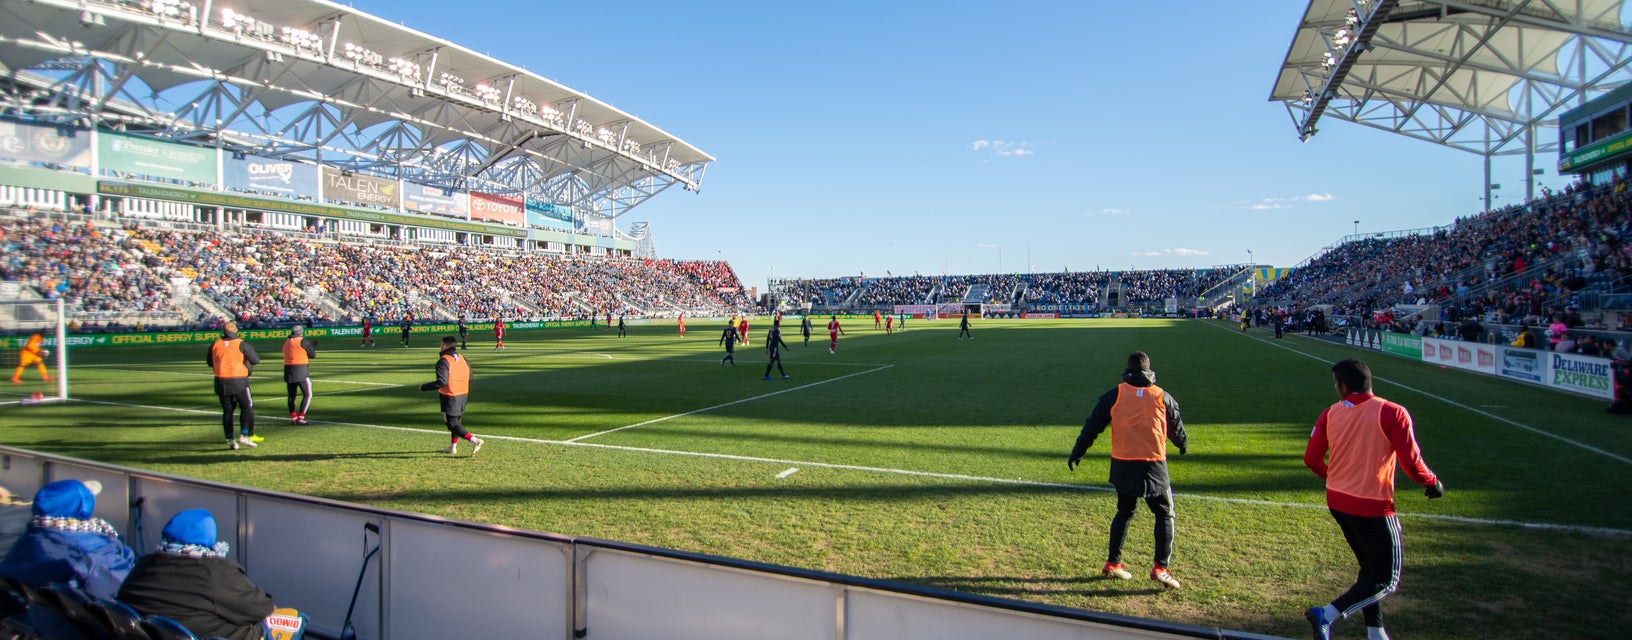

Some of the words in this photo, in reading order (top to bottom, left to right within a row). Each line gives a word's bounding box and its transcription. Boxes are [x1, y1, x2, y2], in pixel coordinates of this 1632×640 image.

[248, 163, 293, 174] OLIVER
[328, 173, 378, 194] TALEN
[357, 192, 392, 204] ENERGY
[54, 336, 94, 345] EERGY
[112, 335, 154, 344] OFFICIAL
[156, 333, 192, 342] ENERGY
[304, 329, 327, 337] UNION
[350, 327, 374, 335] ENEY
[1553, 354, 1608, 377] DELAWARE
[1553, 370, 1609, 391] EXPRESS
